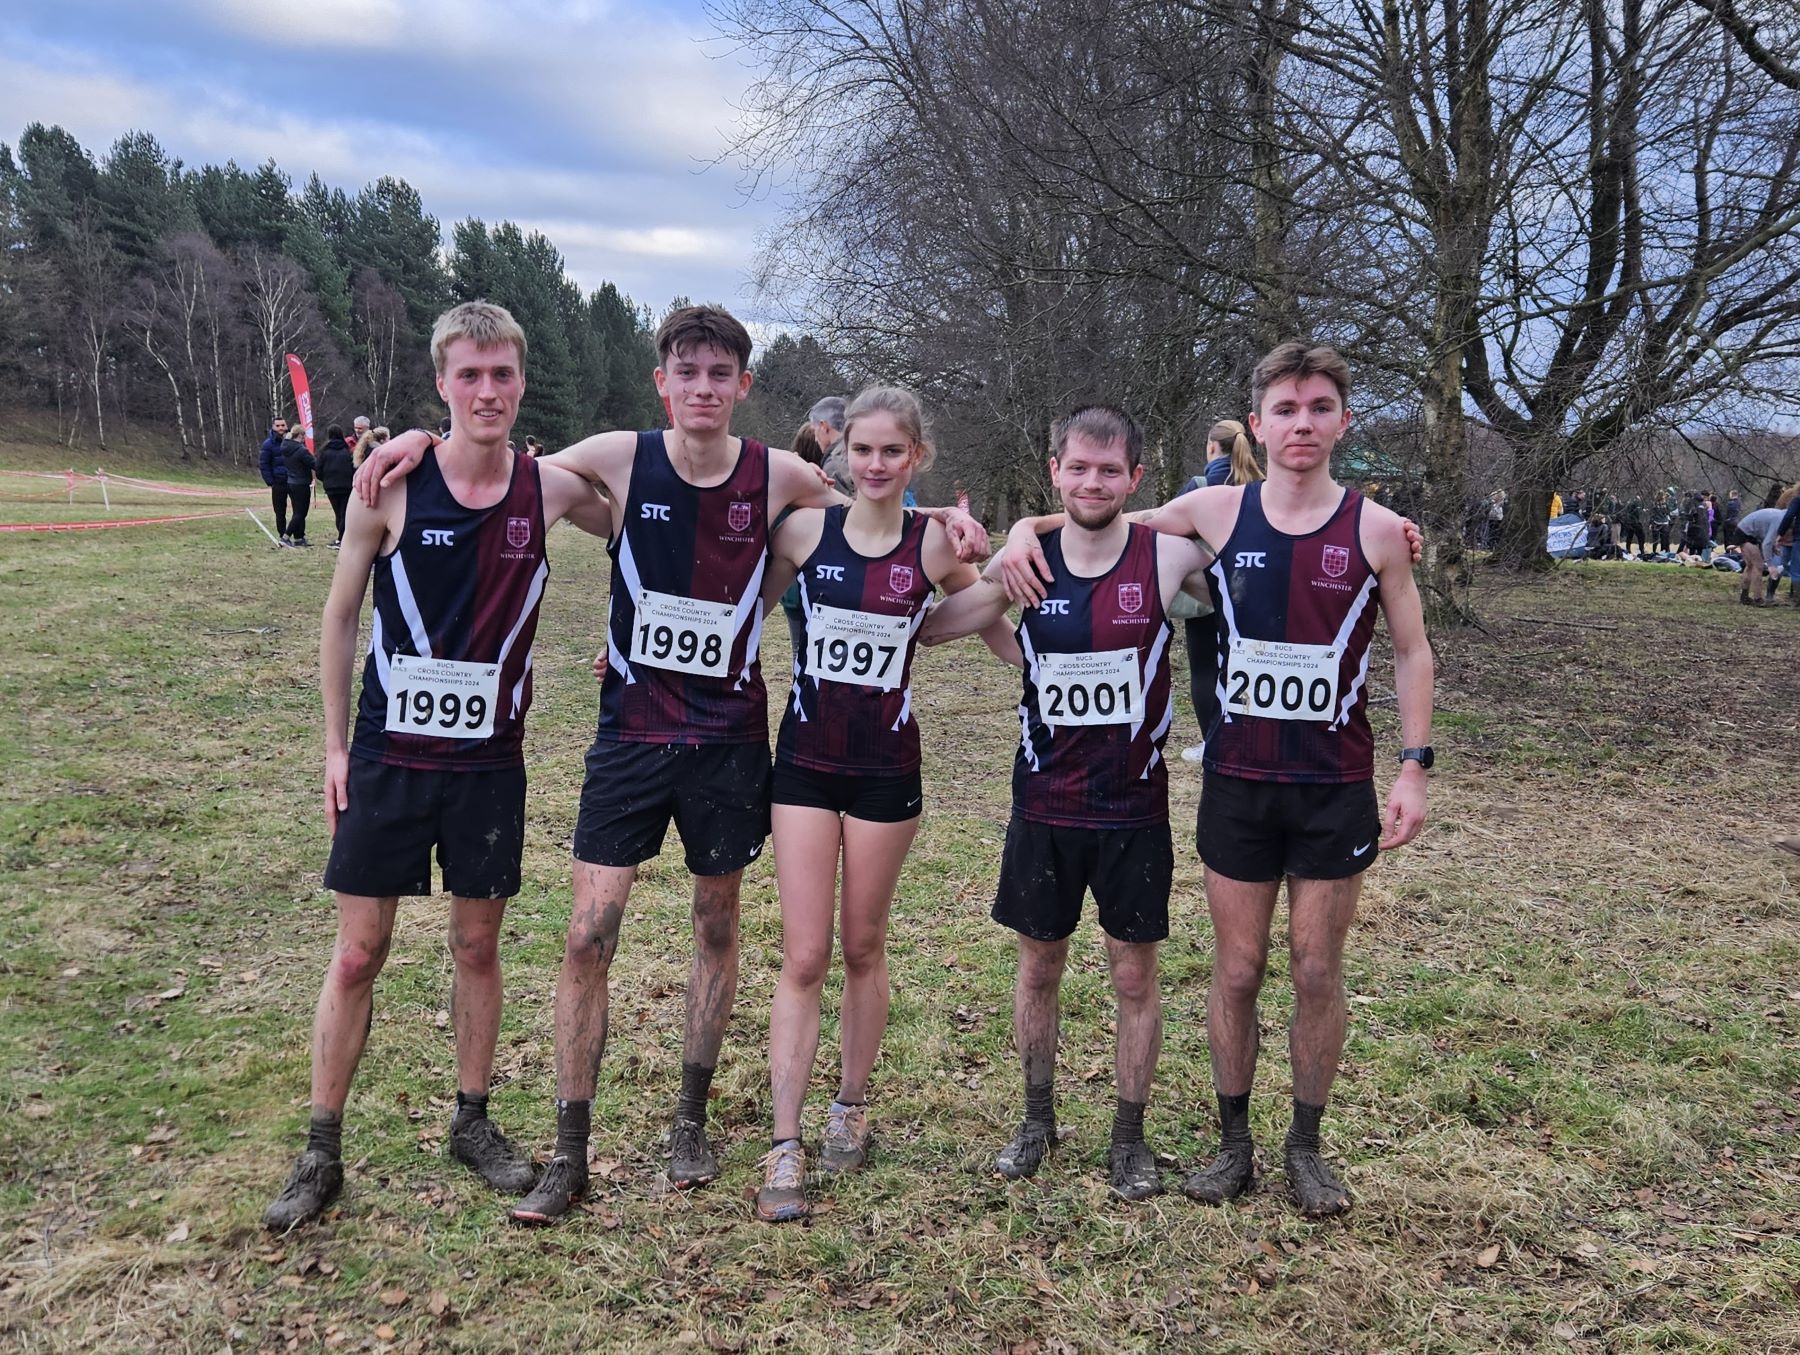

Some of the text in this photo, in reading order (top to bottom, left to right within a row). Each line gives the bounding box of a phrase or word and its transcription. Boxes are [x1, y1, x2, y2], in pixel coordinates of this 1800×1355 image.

[641, 503, 671, 521] STC
[421, 529, 454, 546] STC
[718, 535, 755, 543] WINCHESTER
[1234, 552, 1266, 568] STC
[816, 564, 845, 582] STC
[1311, 580, 1352, 592] WINCHESTER
[879, 595, 915, 606] WINCHESTER
[1040, 599, 1070, 615] STC
[651, 610, 702, 623] CHAMPIONSHIPS
[660, 604, 711, 617] CROSS COUNTRY
[825, 624, 875, 637] CHAMPIONSHIPS
[834, 618, 885, 630] CROSS COUNTRY
[640, 623, 722, 668] 1998
[814, 637, 898, 678] 1997
[1246, 658, 1302, 668] CHAMPIONSHIPS
[1279, 653, 1311, 661] COUNTRY
[408, 675, 463, 685] CHAMPIONSHIPS
[441, 670, 472, 678] COUNTRY
[1229, 671, 1331, 712] 2000
[1045, 680, 1131, 717] 2001
[396, 689, 487, 730] 1999
